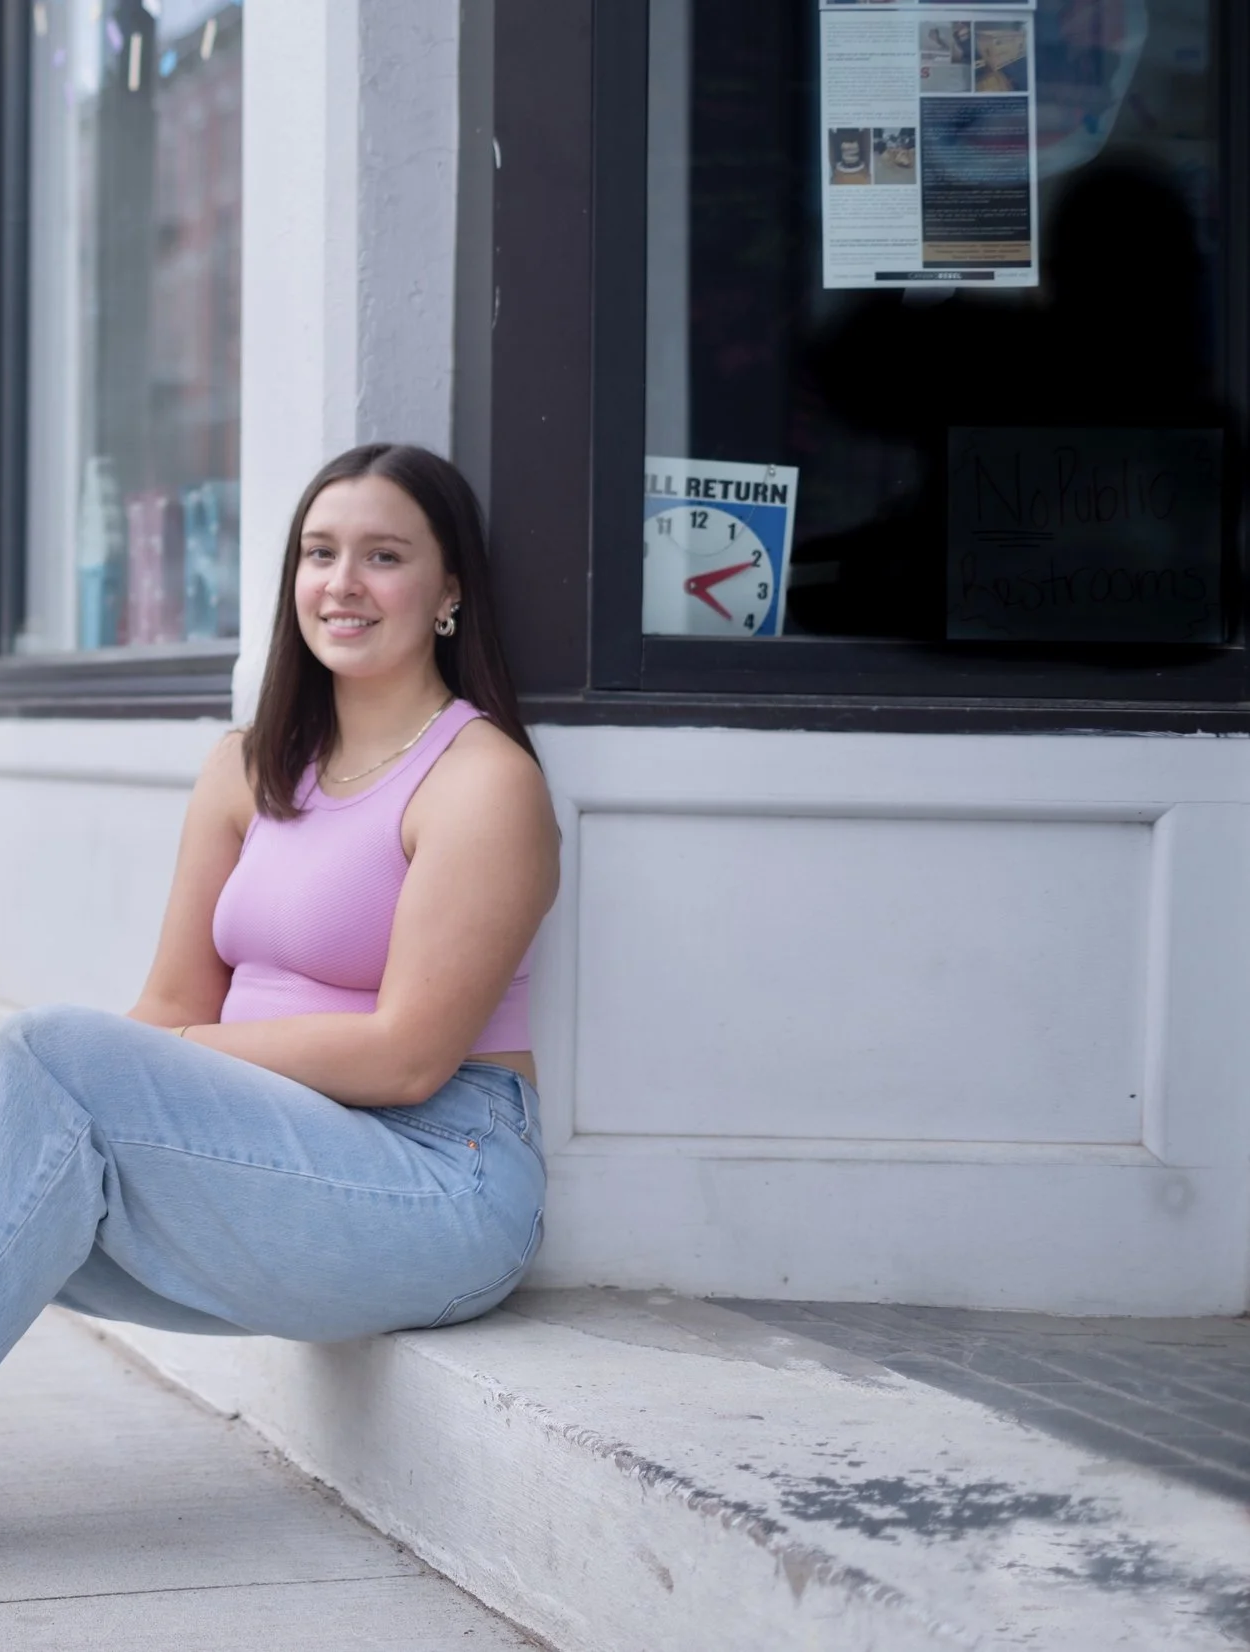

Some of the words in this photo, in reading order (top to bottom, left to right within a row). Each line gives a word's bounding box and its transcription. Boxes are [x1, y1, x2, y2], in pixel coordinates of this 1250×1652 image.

[686, 478, 788, 504] RETURN
[974, 451, 1051, 531] No
[1053, 445, 1176, 525] Public
[656, 517, 672, 536] 11
[690, 511, 709, 529] 12
[728, 523, 736, 540] 1
[751, 550, 762, 568] 2
[757, 582, 768, 600] 3
[959, 552, 1207, 612] Restrooms
[743, 613, 755, 631] 4
